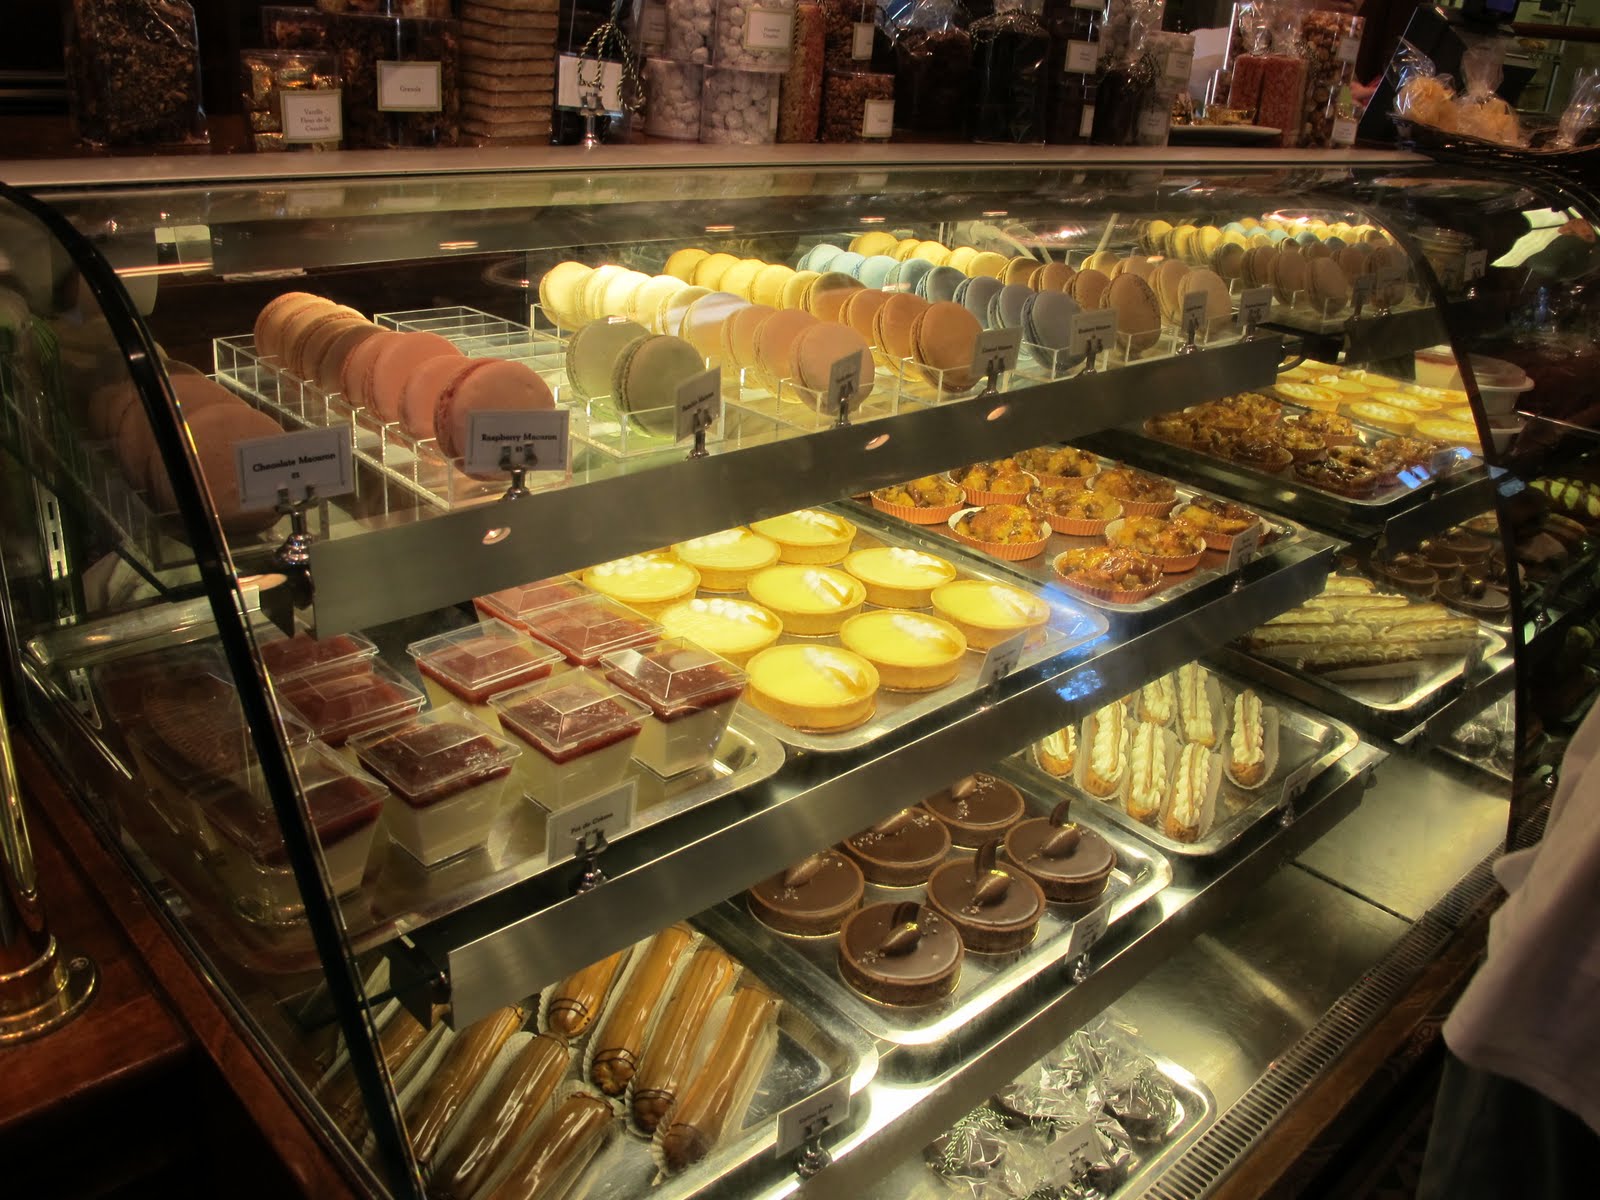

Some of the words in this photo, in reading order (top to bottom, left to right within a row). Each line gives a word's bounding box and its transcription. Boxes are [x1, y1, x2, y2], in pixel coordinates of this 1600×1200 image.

[481, 434, 521, 442] Raspberry
[523, 433, 558, 441] Macaron
[252, 459, 296, 472] Chocolate
[298, 452, 336, 465] Macaron
